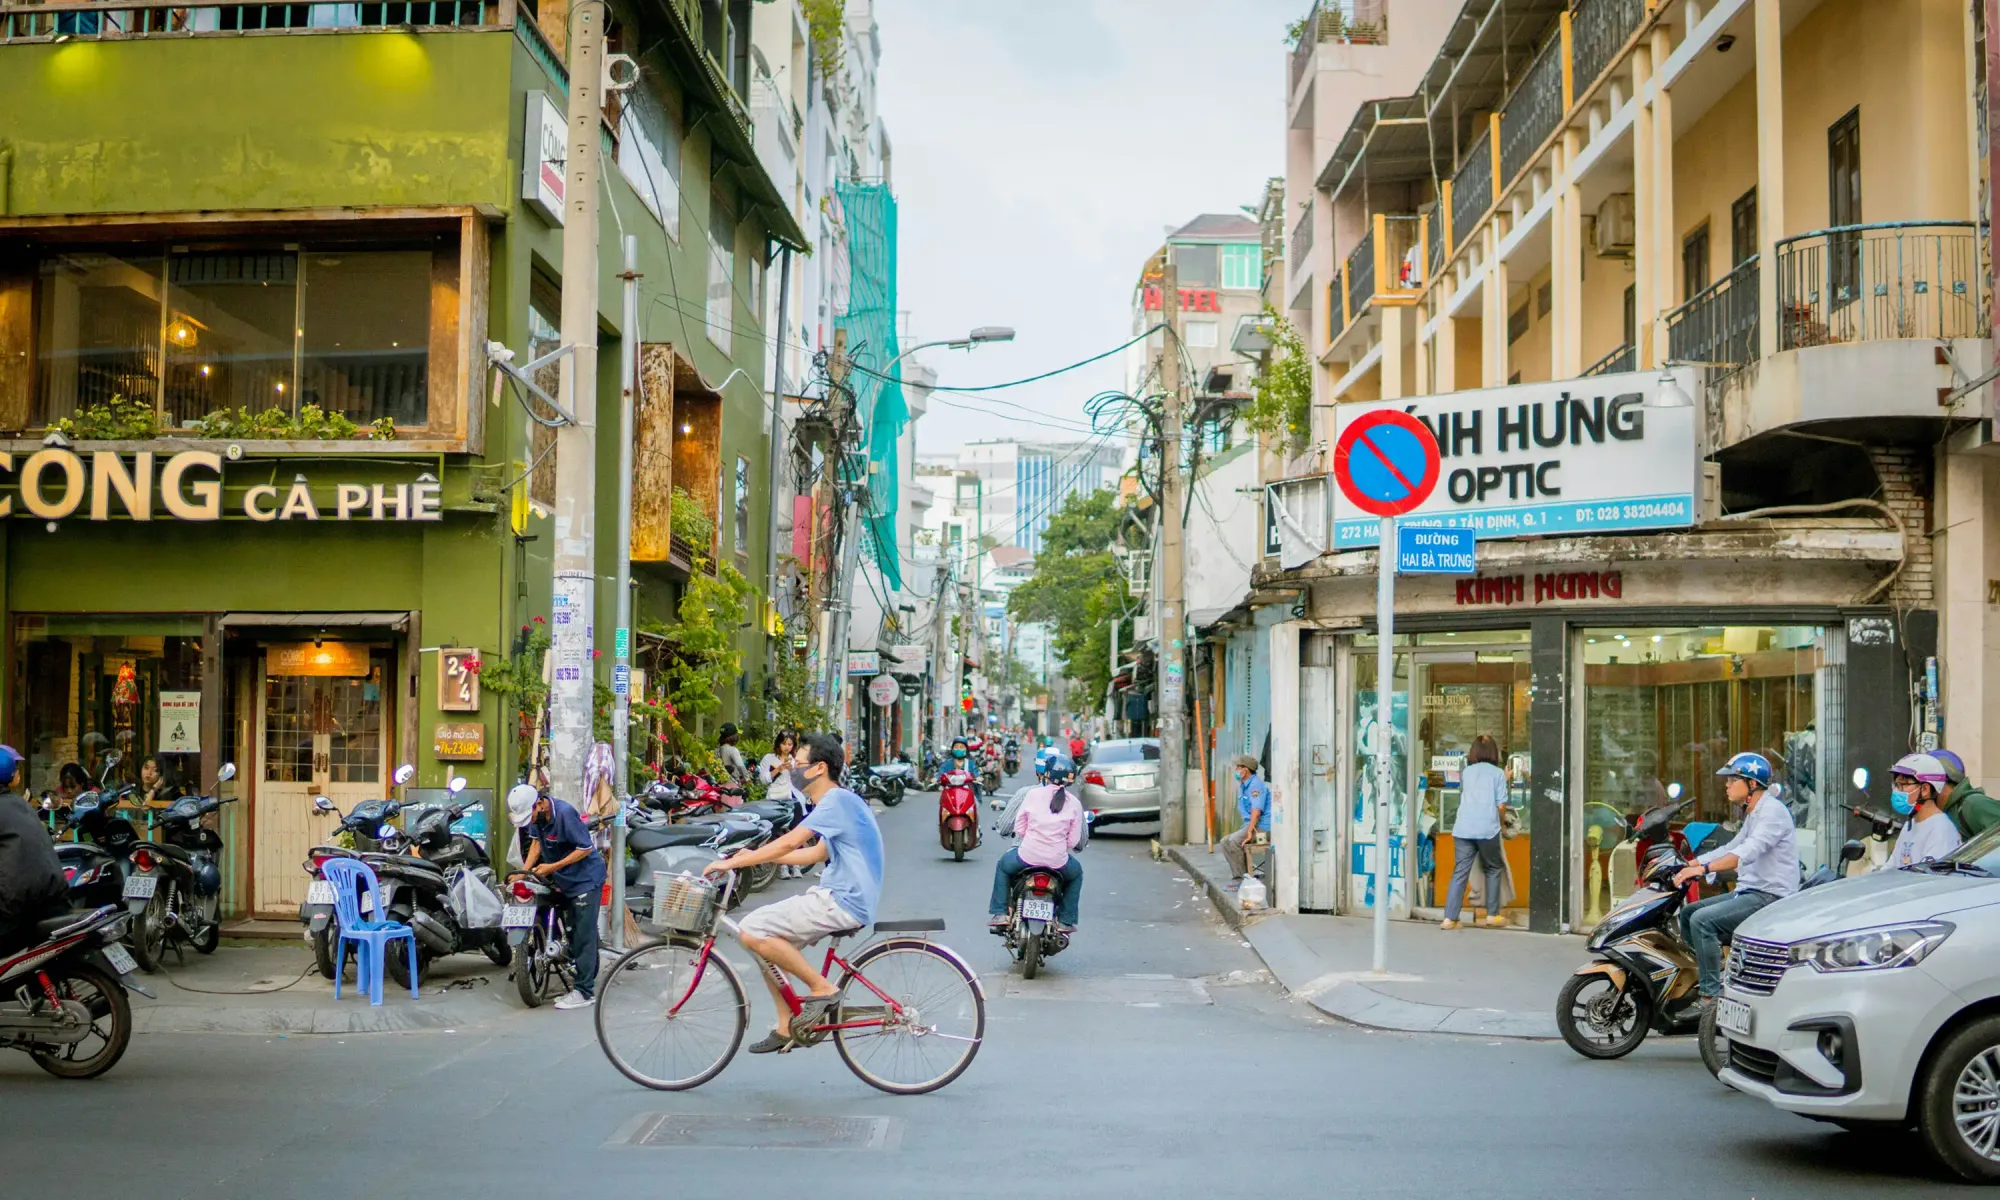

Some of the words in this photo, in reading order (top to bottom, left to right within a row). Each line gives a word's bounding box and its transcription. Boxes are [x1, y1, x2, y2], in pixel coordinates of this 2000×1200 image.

[1144, 288, 1221, 311] HTEL
[1498, 391, 1646, 453] HƯNG
[0, 429, 222, 533] ỘNG
[243, 474, 319, 522] CÂ
[337, 473, 443, 522] PHÊ
[1447, 460, 1562, 504] OPTIC
[1342, 525, 1361, 540] 272
[1364, 524, 1381, 538] HA
[1541, 511, 1547, 525] 1
[1576, 508, 1594, 522] ĐT:
[1598, 506, 1620, 520] 028
[1624, 502, 1685, 519] 38204404
[1415, 531, 1459, 546] ĐƯỜNG
[1402, 553, 1420, 567] HAI
[1421, 549, 1436, 567] BÀ
[1438, 552, 1472, 568] TRƯNG
[1455, 572, 1525, 606] KÍNH
[1422, 692, 1444, 706] KÍNH
[1028, 902, 1048, 910] 59-B1
